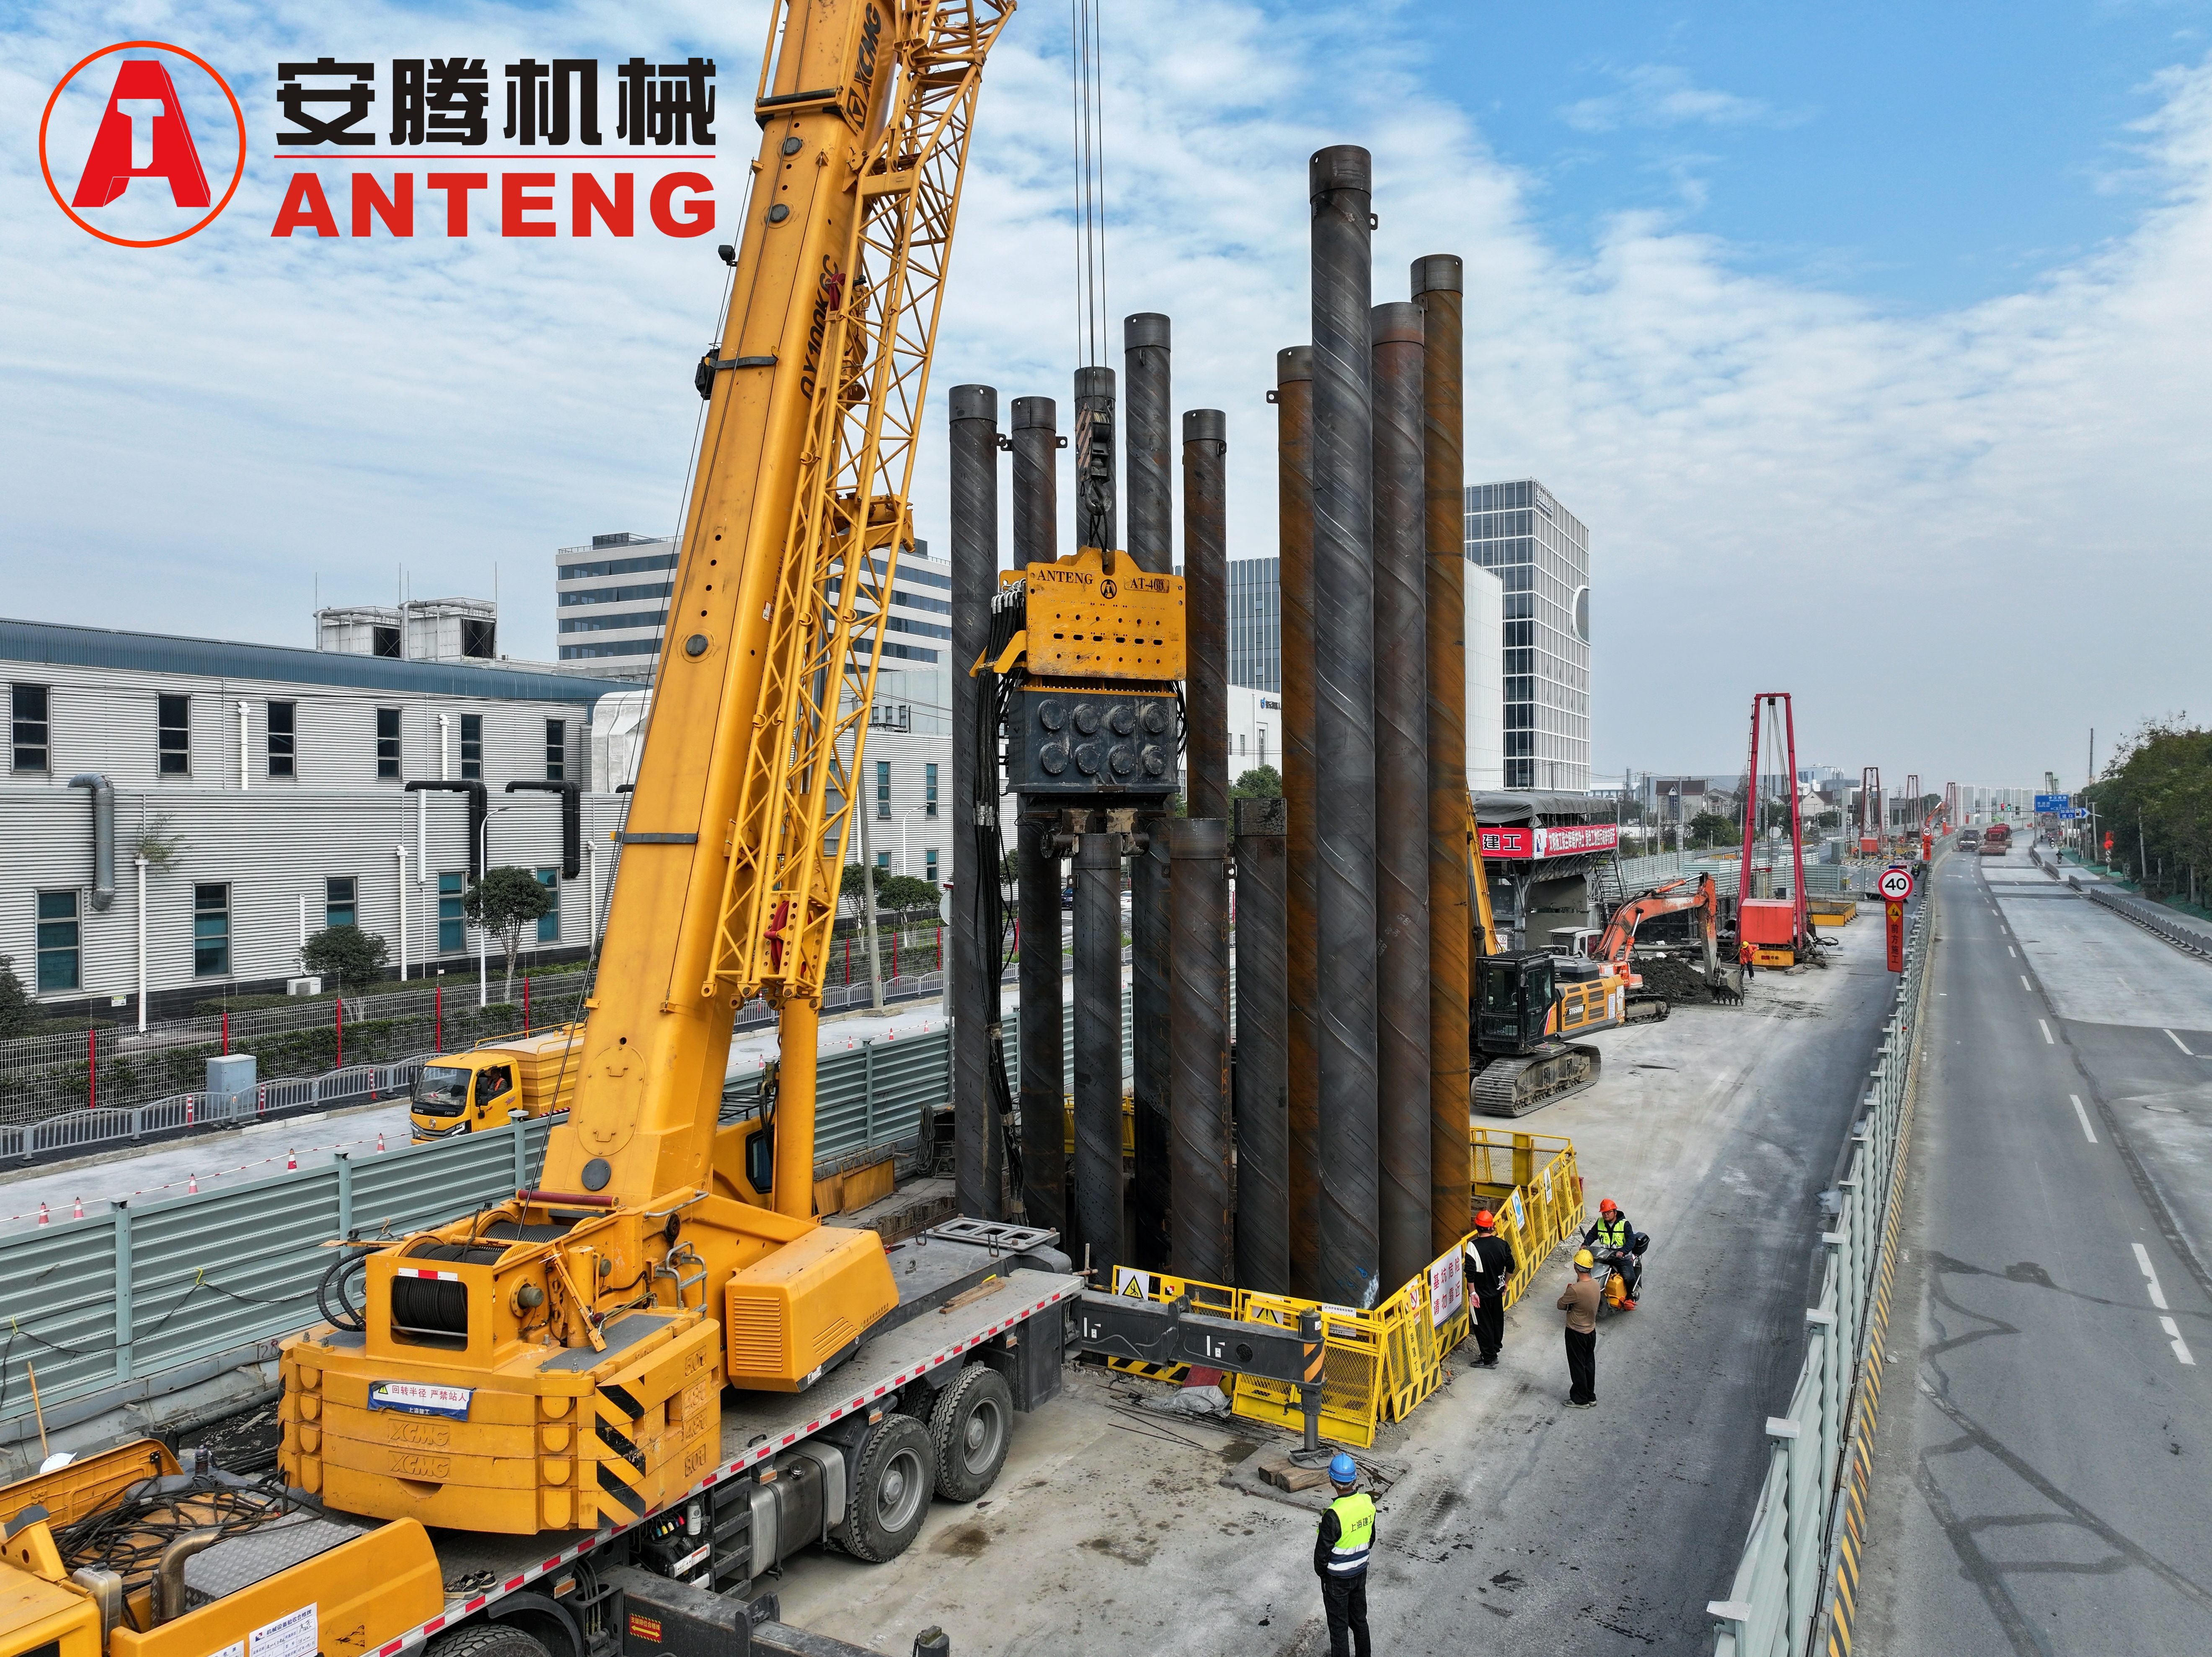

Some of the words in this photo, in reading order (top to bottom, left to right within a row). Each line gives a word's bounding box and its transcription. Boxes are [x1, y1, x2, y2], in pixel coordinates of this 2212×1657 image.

[854, 3, 882, 104] XCMG
[1037, 569, 1093, 585] ANTENG
[1483, 834, 1521, 850] 建工
[1885, 878, 1906, 890] 40
[1434, 1256, 1460, 1290] 基坑危险
[1434, 1280, 1460, 1316] 请勿靠近
[392, 1385, 426, 1398] 回转半径
[430, 1389, 467, 1402] 严禁站人
[390, 1423, 449, 1446] XCMG
[390, 1455, 449, 1478] XCMG
[1351, 1514, 1372, 1533] 上海建工
